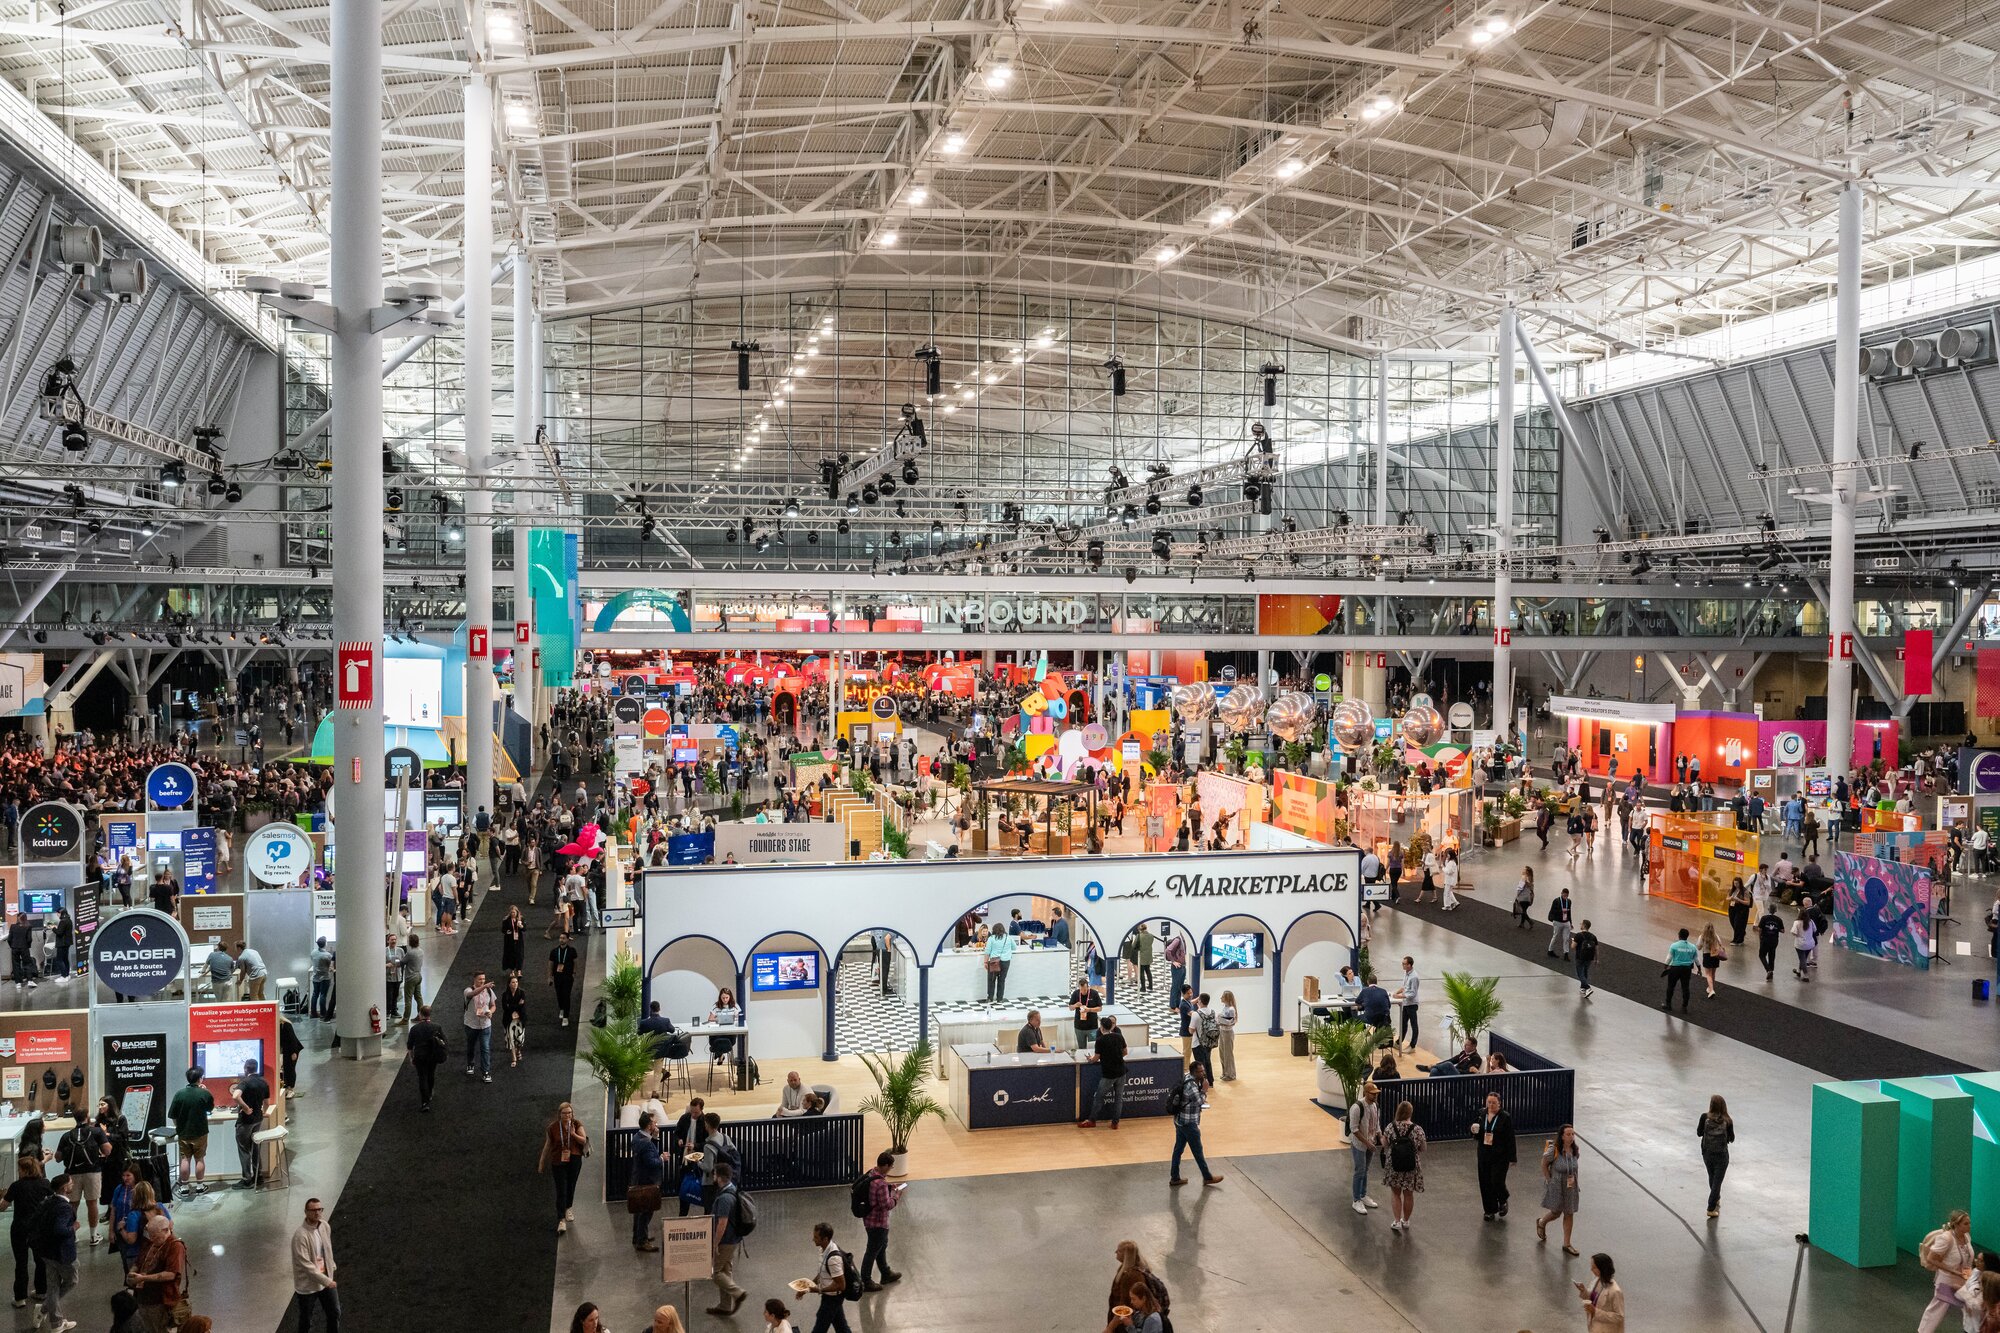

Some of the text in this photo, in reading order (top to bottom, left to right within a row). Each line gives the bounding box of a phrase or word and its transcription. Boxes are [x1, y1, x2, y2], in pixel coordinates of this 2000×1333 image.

[930, 599, 1088, 625] INBOUND
[262, 832, 296, 840] salesmsg
[33, 838, 68, 847] kaltura
[749, 838, 811, 853] FOUNDERS STAGE
[1663, 838, 1681, 847] INBOUND
[1715, 849, 1744, 861] INBOUND 24
[1108, 873, 1348, 899] ink. MARKETPLACE
[100, 948, 176, 962] BADGER
[121, 970, 151, 978] HubSpot
[1012, 1087, 1053, 1104] ink.
[1134, 1094, 1159, 1102] business
[668, 1231, 707, 1242] PHOTOGRAPHY
